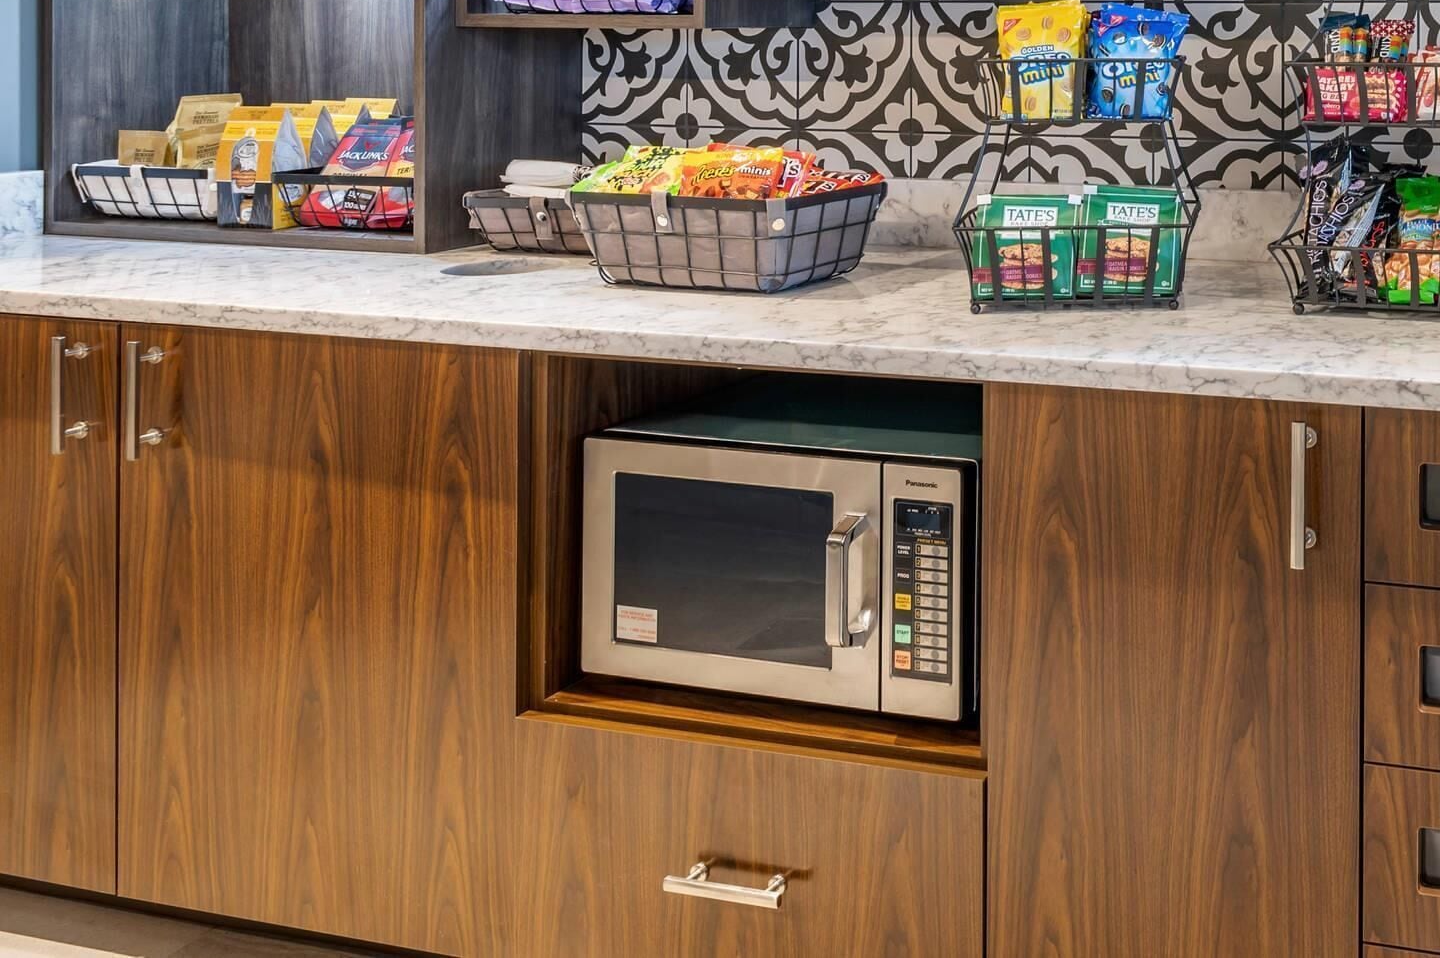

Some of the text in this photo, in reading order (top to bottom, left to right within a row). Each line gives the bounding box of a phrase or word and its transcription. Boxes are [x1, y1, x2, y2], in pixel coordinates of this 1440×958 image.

[1329, 29, 1340, 54] KIND
[1380, 35, 1391, 58] KIND
[1021, 45, 1054, 54] GOLDEN
[1119, 70, 1160, 87] mni
[337, 150, 360, 160] JACK
[740, 167, 773, 176] minis
[1007, 208, 1055, 222] TATE'S
[1110, 205, 1156, 218] TATE'S
[905, 479, 938, 489] Panasonic
